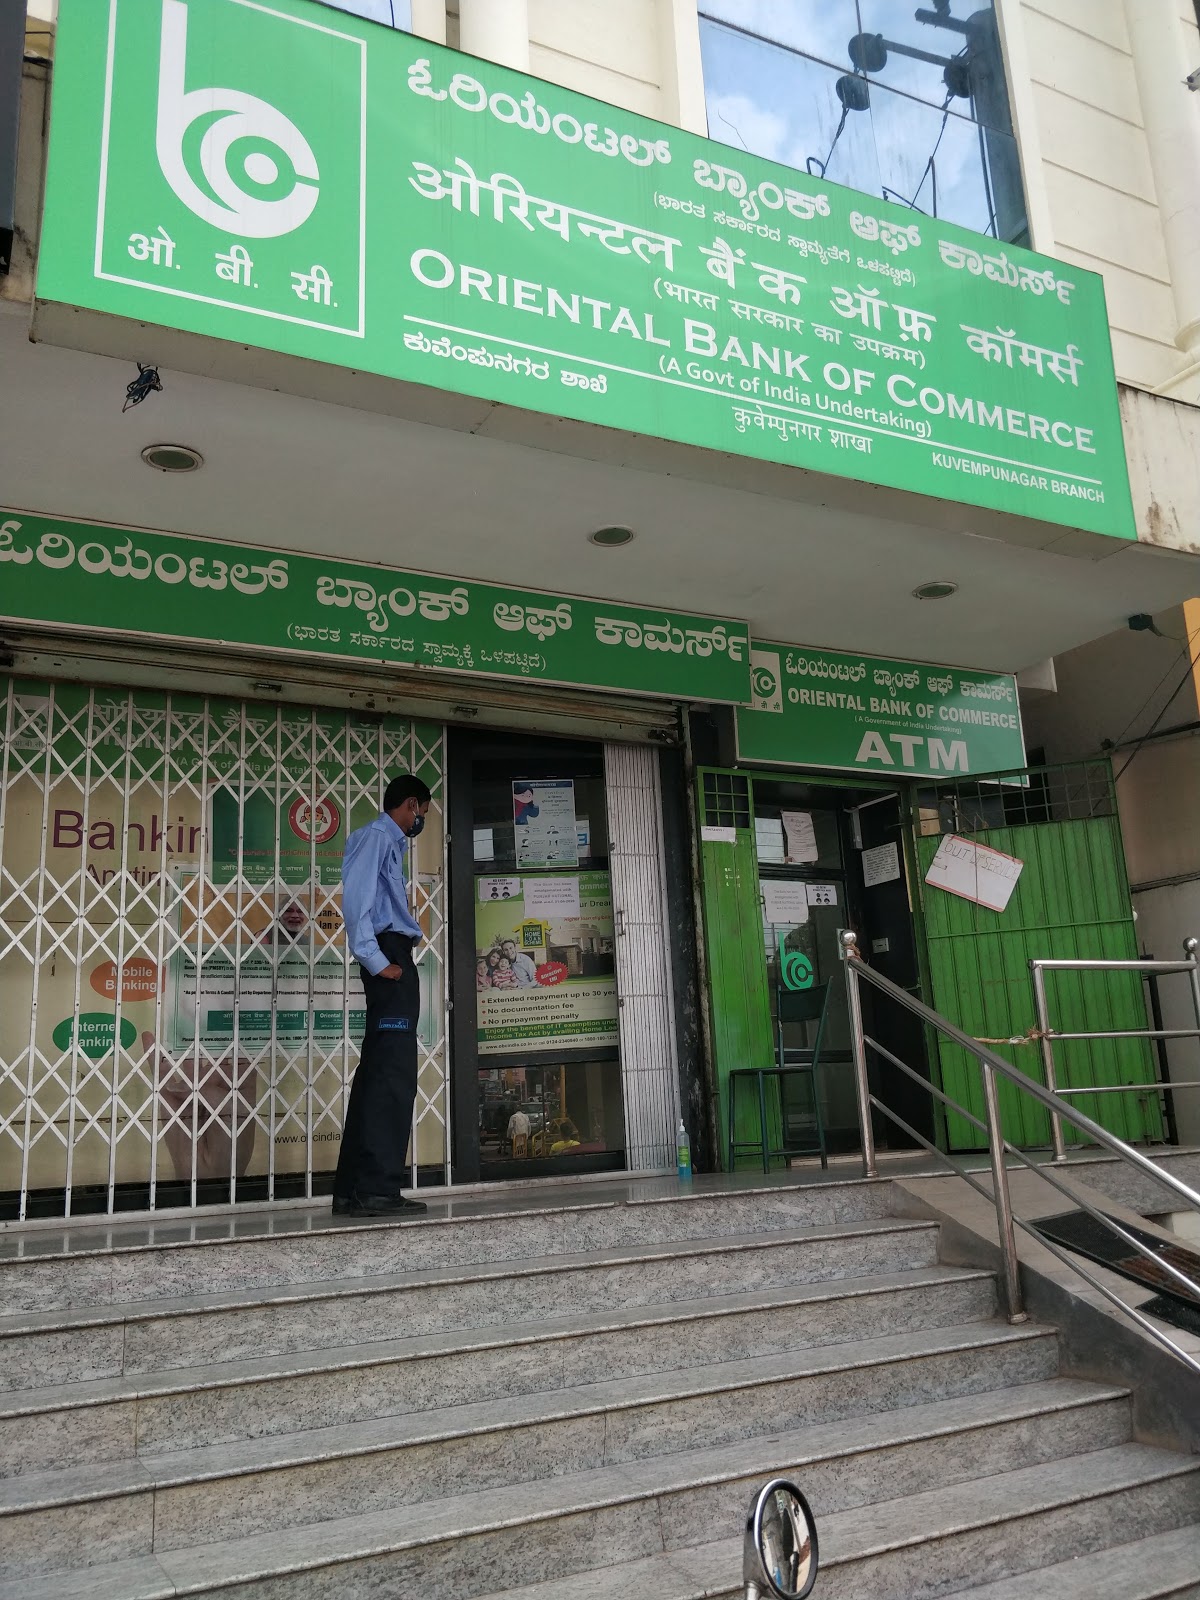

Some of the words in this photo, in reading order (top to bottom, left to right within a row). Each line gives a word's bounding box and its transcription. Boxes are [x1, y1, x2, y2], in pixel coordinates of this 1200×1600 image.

[407, 58, 672, 167] ಓರಿಯಂಟಲ್
[693, 159, 831, 221] ಬ್ಯಾಂಕ್
[850, 211, 921, 255] ಆಫ್
[938, 240, 1076, 306] ಕಾಮರ್ಸ್
[653, 192, 706, 219] (ಭಾರತ
[713, 211, 781, 242] ಸರ್ಕಾರದ
[127, 225, 181, 270] ओ.
[215, 244, 259, 288] बी.
[290, 264, 339, 307] सी.
[408, 156, 683, 272] ओरियन्टल
[959, 324, 1084, 387] कॉमर्स
[653, 277, 720, 311] (भारत
[728, 299, 804, 335] सरकार
[811, 321, 843, 346] का
[849, 332, 926, 370] उपक्रम)
[402, 331, 550, 380] ಕುವೆಂಪುನಗರ
[560, 369, 608, 394] ಶಾಖೆ
[410, 248, 671, 348] ORIENTAL
[683, 317, 812, 383] BANK
[823, 362, 876, 395] OF
[887, 373, 1097, 455] COMMERCE
[658, 354, 682, 376] (A
[686, 361, 735, 388] Govt
[739, 376, 761, 394] of
[764, 380, 811, 406] India
[815, 392, 933, 438] Undertaking)
[732, 404, 822, 442] कुवेम्पुनगर
[828, 428, 873, 454] शाखा
[931, 451, 1048, 491] KUVEMPUNAGAR
[1051, 478, 1105, 503] BRANCH
[286, 622, 341, 643] (ಭಾರತ
[349, 630, 415, 652] ಸರ್ಕಾರದ
[316, 576, 470, 632] ಬ್ಯಾಂಕ್
[493, 602, 573, 642] ಆಫ್
[594, 617, 747, 662] ಕಾಮರ್ಸ್
[785, 652, 867, 682] ಓರಿಯಂಟಲ್
[873, 669, 920, 697] ಬ್ಯಾಂಕ್
[926, 675, 954, 697] ಆಫ್
[787, 687, 866, 712] ORIENTAL
[869, 697, 912, 717] BANK
[915, 702, 935, 719] OF
[938, 705, 1018, 730] COMMERCE
[864, 716, 901, 727] Government
[902, 719, 909, 727] of
[909, 721, 925, 730] India
[925, 723, 963, 735] Undertaking)
[220, 759, 232, 770] of
[855, 731, 970, 773] ATM
[944, 842, 971, 859] OUT
[105, 979, 157, 992] Bnking
[487, 995, 525, 1005] Extended
[526, 992, 569, 1003] repayment
[570, 992, 581, 1000] up
[484, 1027, 505, 1035] Enjoy
[520, 1024, 545, 1032] benefit
[563, 1020, 601, 1029] exemption
[487, 1007, 499, 1015] No
[500, 1003, 560, 1013] documentation
[488, 1018, 500, 1026] No
[501, 1015, 549, 1026] prepayment
[550, 1012, 580, 1022] penalty
[542, 1029, 551, 1037] by
[581, 1025, 603, 1033] Home
[274, 1131, 341, 1144] www.ocindia
